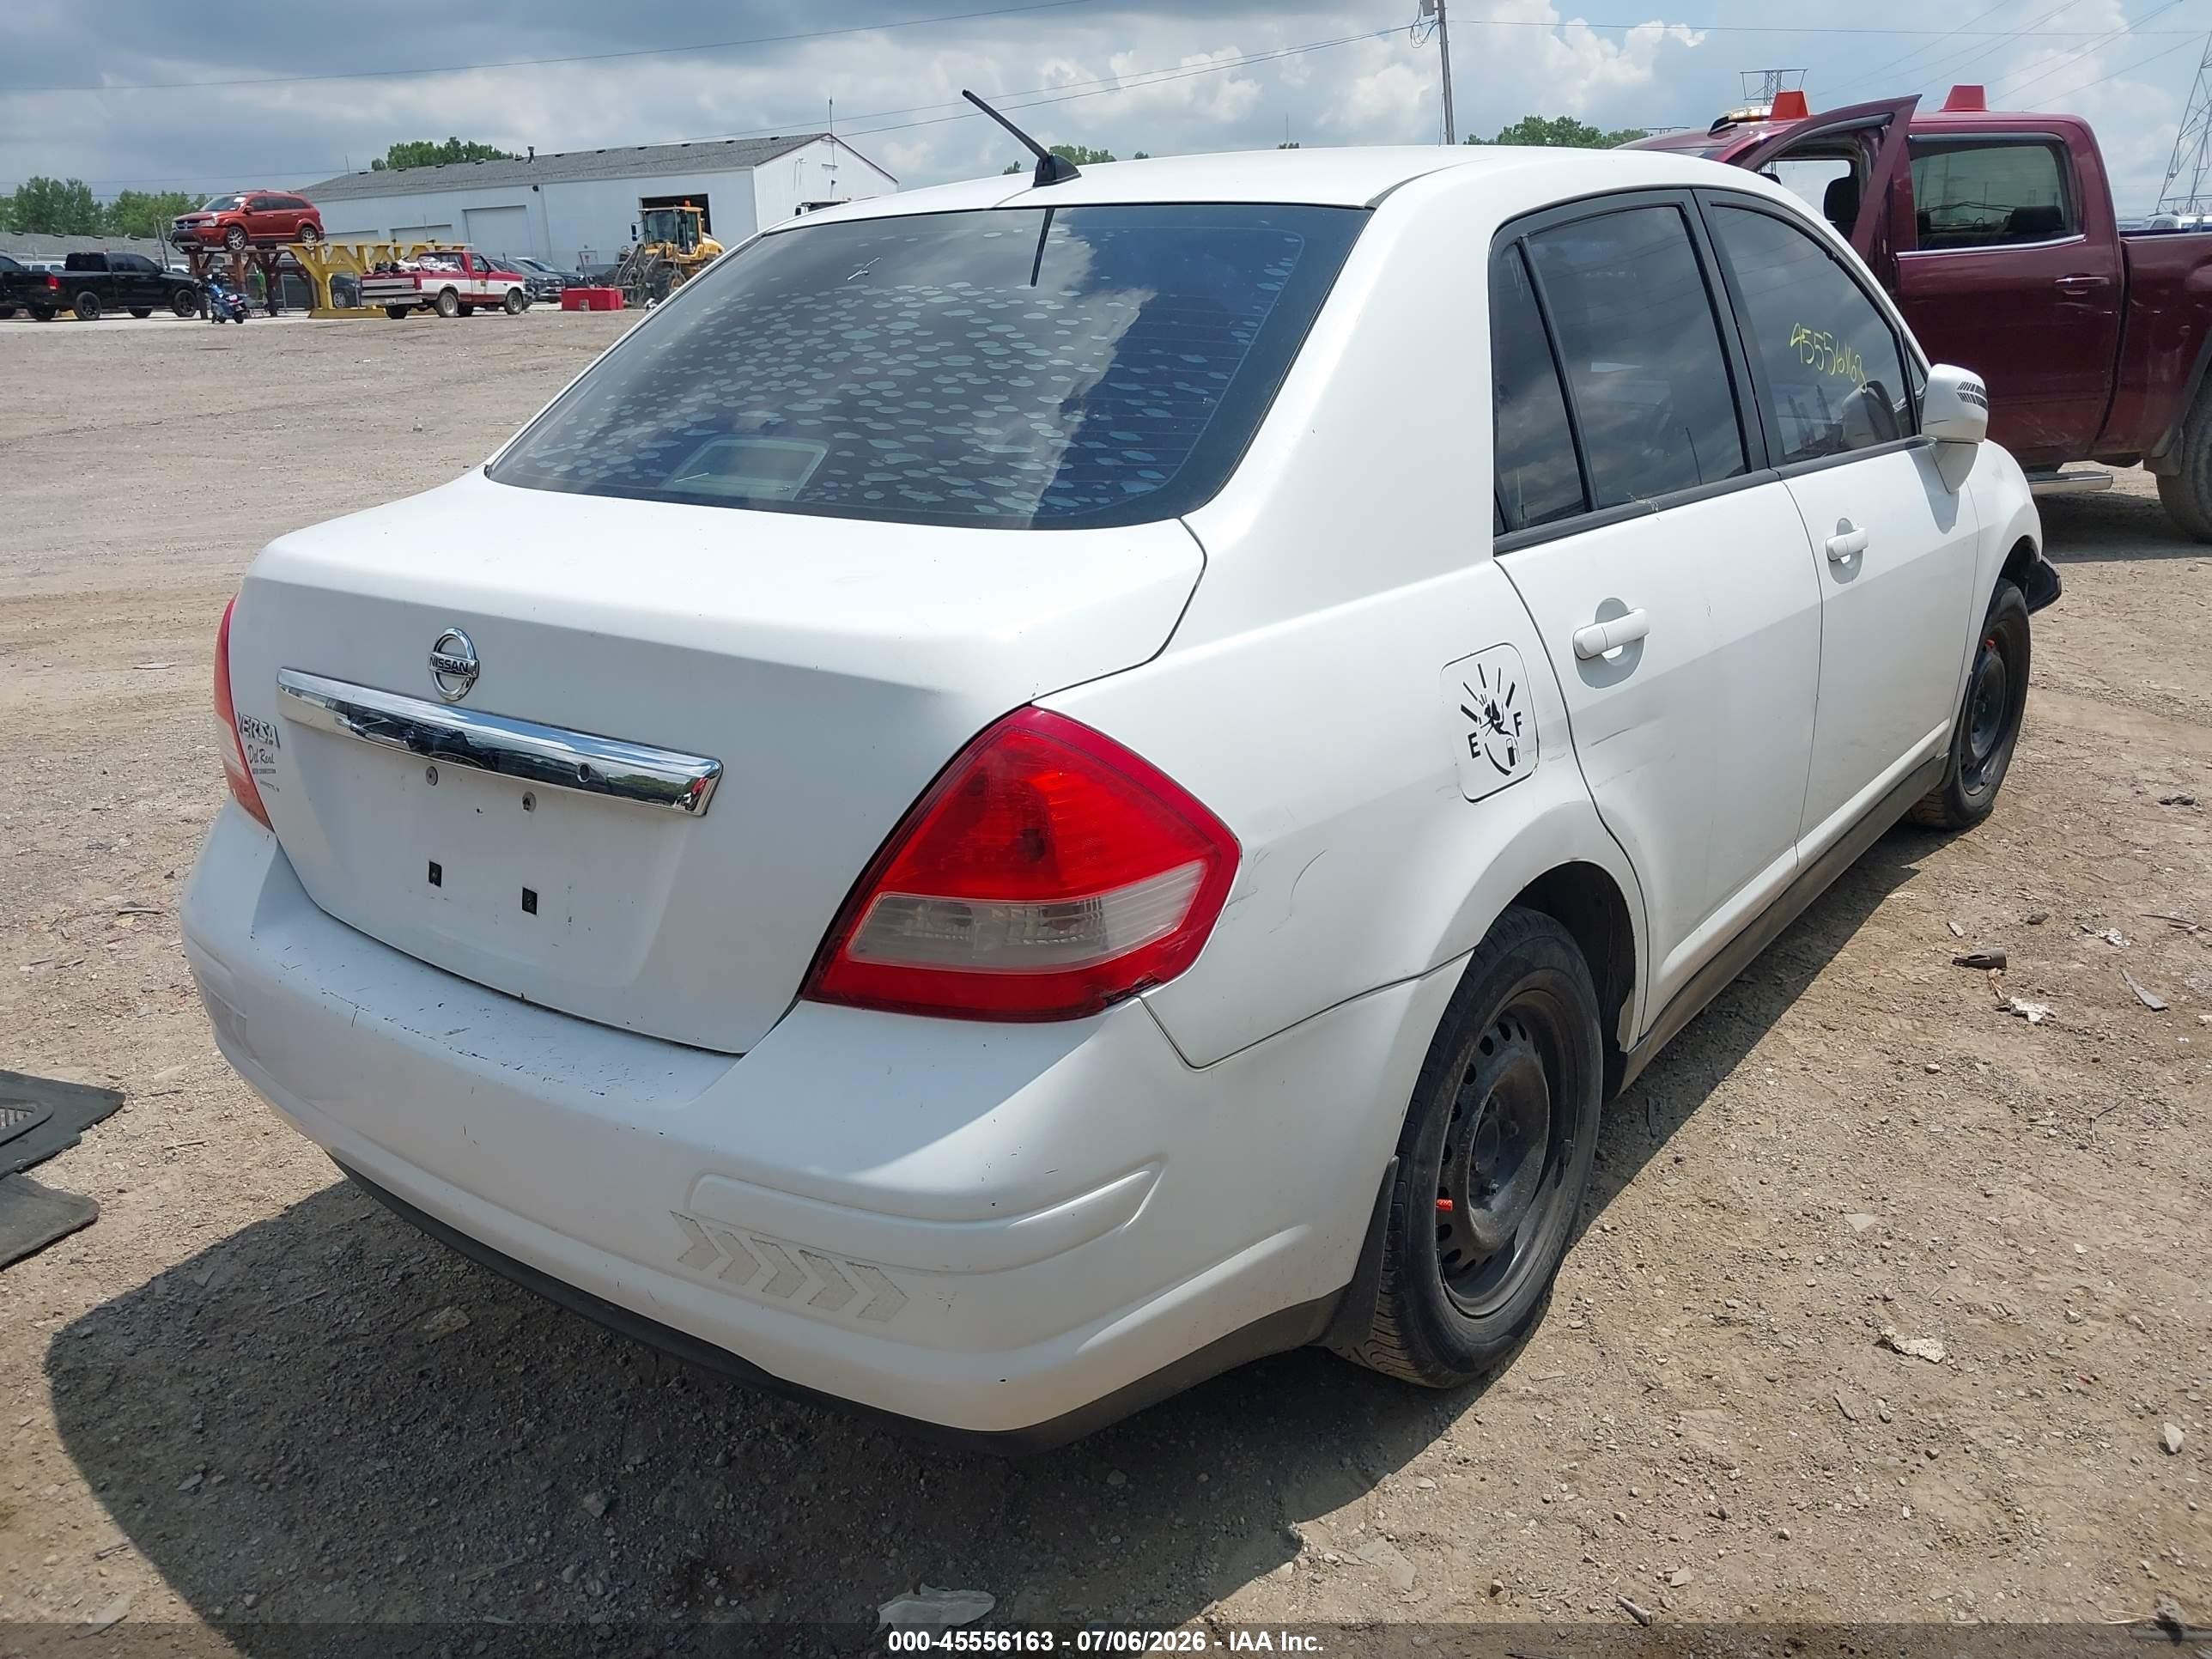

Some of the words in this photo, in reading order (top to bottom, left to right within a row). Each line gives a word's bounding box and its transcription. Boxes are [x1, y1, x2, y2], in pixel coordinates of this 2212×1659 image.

[429, 656, 469, 673] NISSAN
[237, 711, 281, 750] VERSA
[1512, 711, 1523, 738] F
[1467, 732, 1481, 759] E
